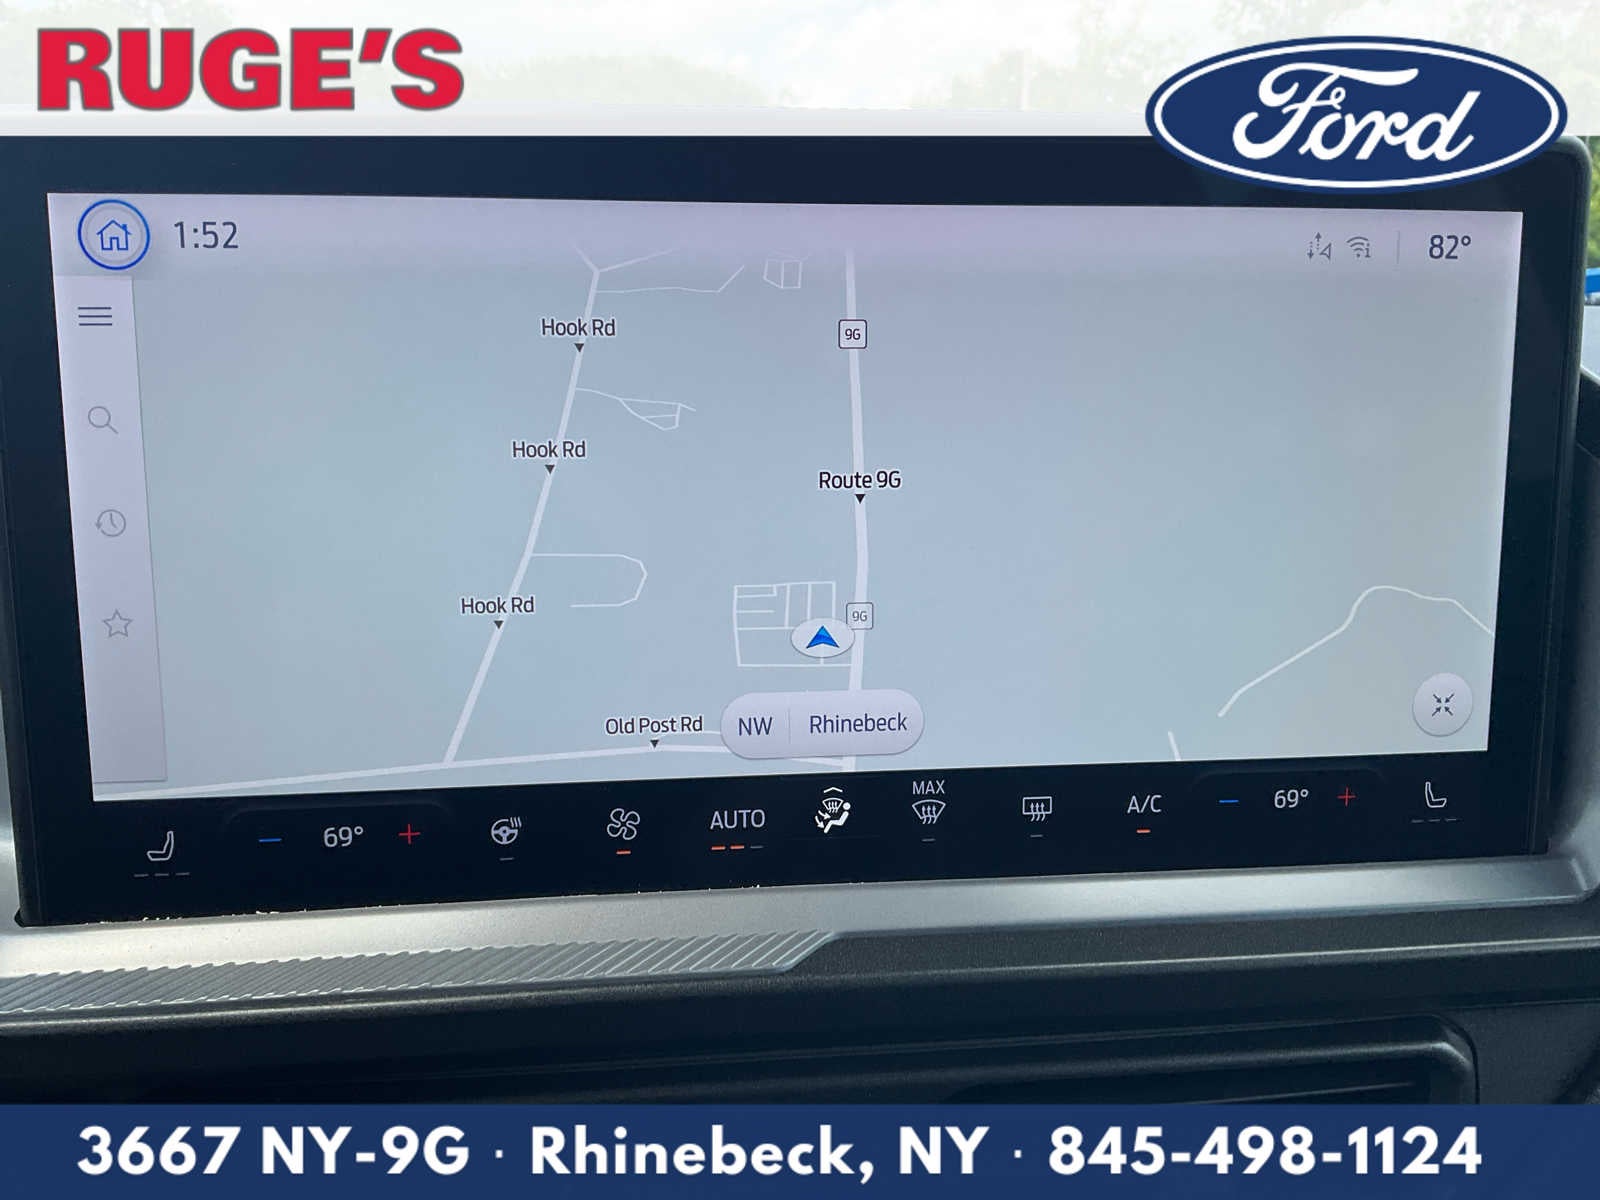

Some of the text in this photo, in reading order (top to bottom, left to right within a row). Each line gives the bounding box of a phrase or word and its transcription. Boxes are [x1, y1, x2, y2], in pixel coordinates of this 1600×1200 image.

[173, 220, 239, 249] 1:52
[1428, 234, 1472, 260] 82°
[541, 318, 616, 337] Hook Rd
[844, 327, 861, 342] 9G
[512, 440, 586, 459] Hook Rd
[818, 471, 901, 490] Route 9G
[460, 596, 535, 615] Hook Rd
[852, 609, 868, 623] 9G
[605, 715, 703, 736] Old Post Rd
[738, 716, 773, 736] NW
[809, 712, 908, 735] Rhinebeck
[912, 780, 946, 796] MAX
[1127, 794, 1162, 814] A/C
[1273, 788, 1310, 810] 69°
[709, 809, 765, 831] AUTO
[323, 826, 364, 849] 69°
